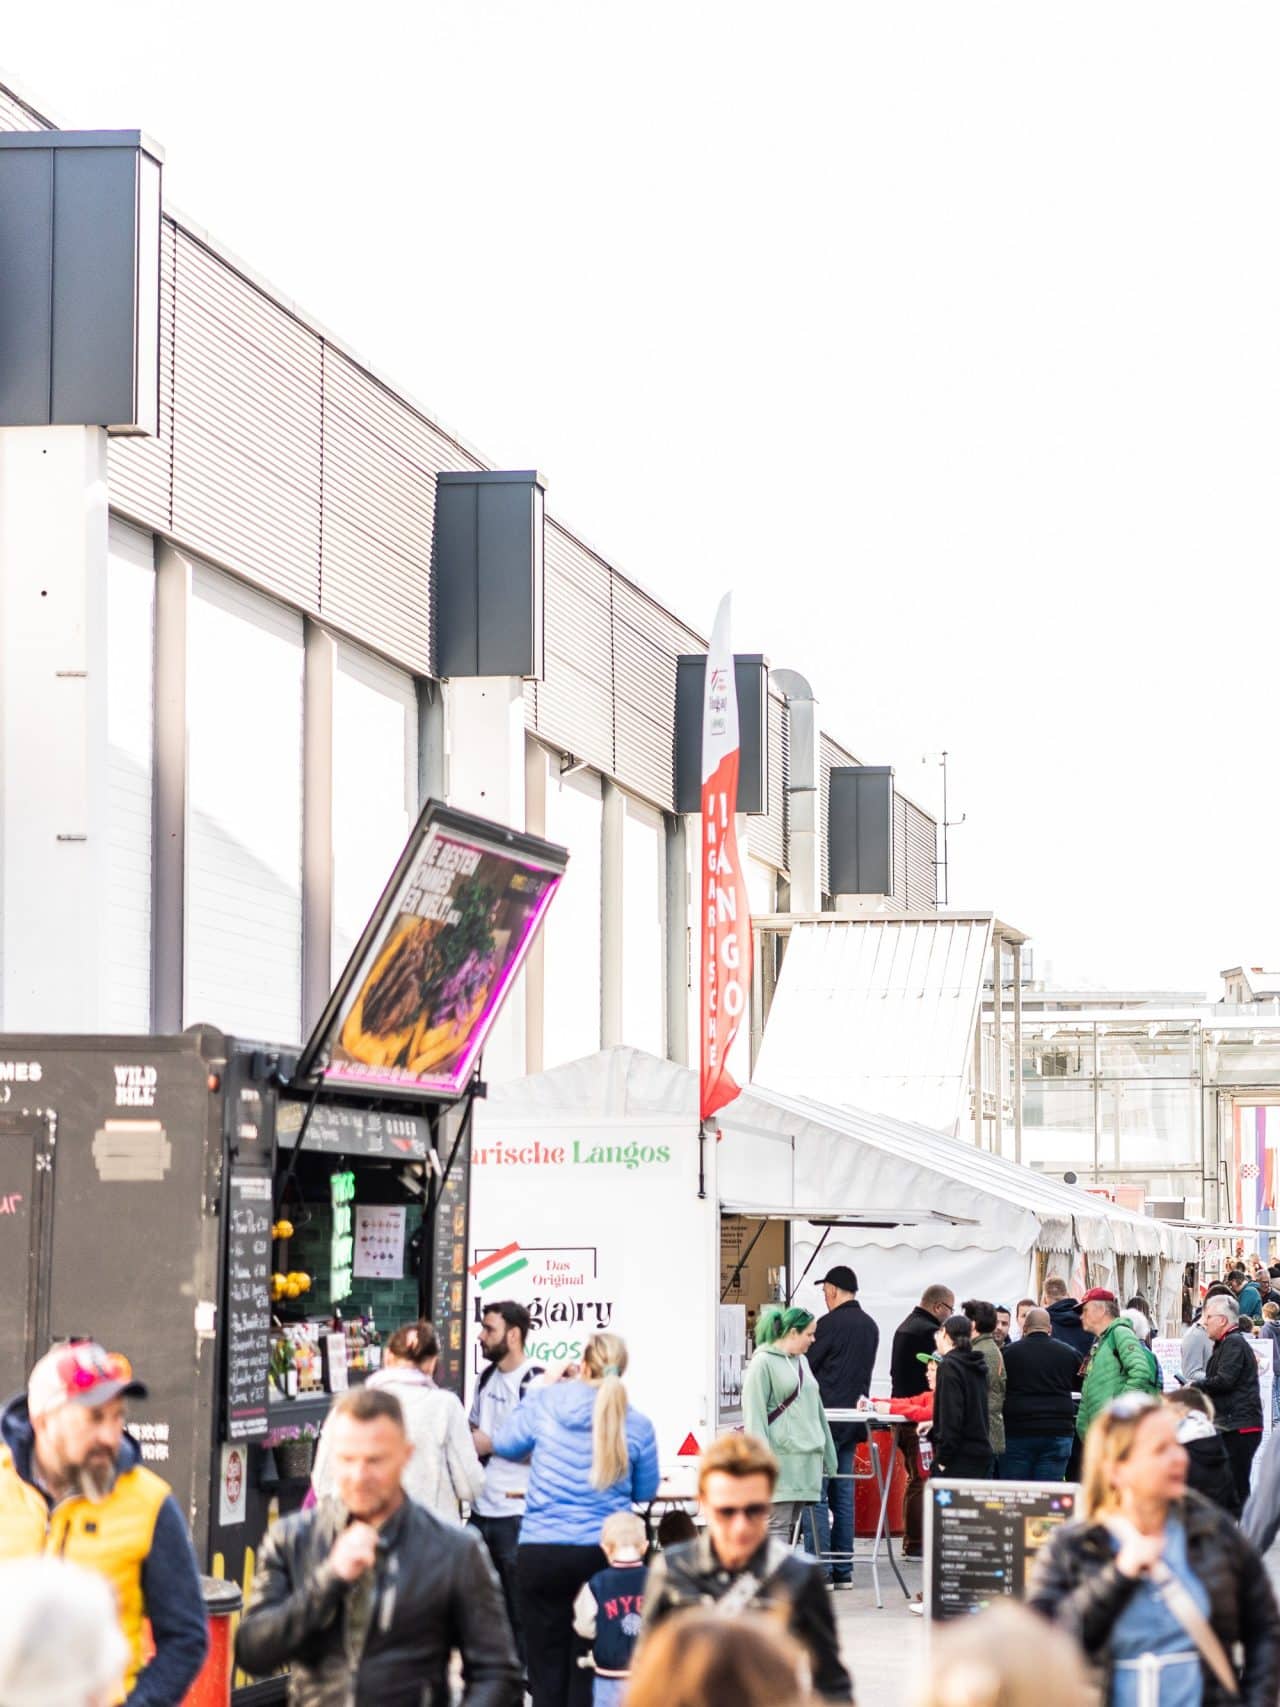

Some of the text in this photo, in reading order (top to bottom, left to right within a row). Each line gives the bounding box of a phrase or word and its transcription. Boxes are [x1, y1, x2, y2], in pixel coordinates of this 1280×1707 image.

[113, 1065, 157, 1085] WILD
[573, 1140, 670, 1170] Langos
[546, 1260, 571, 1271] Das
[532, 1274, 584, 1288] Original
